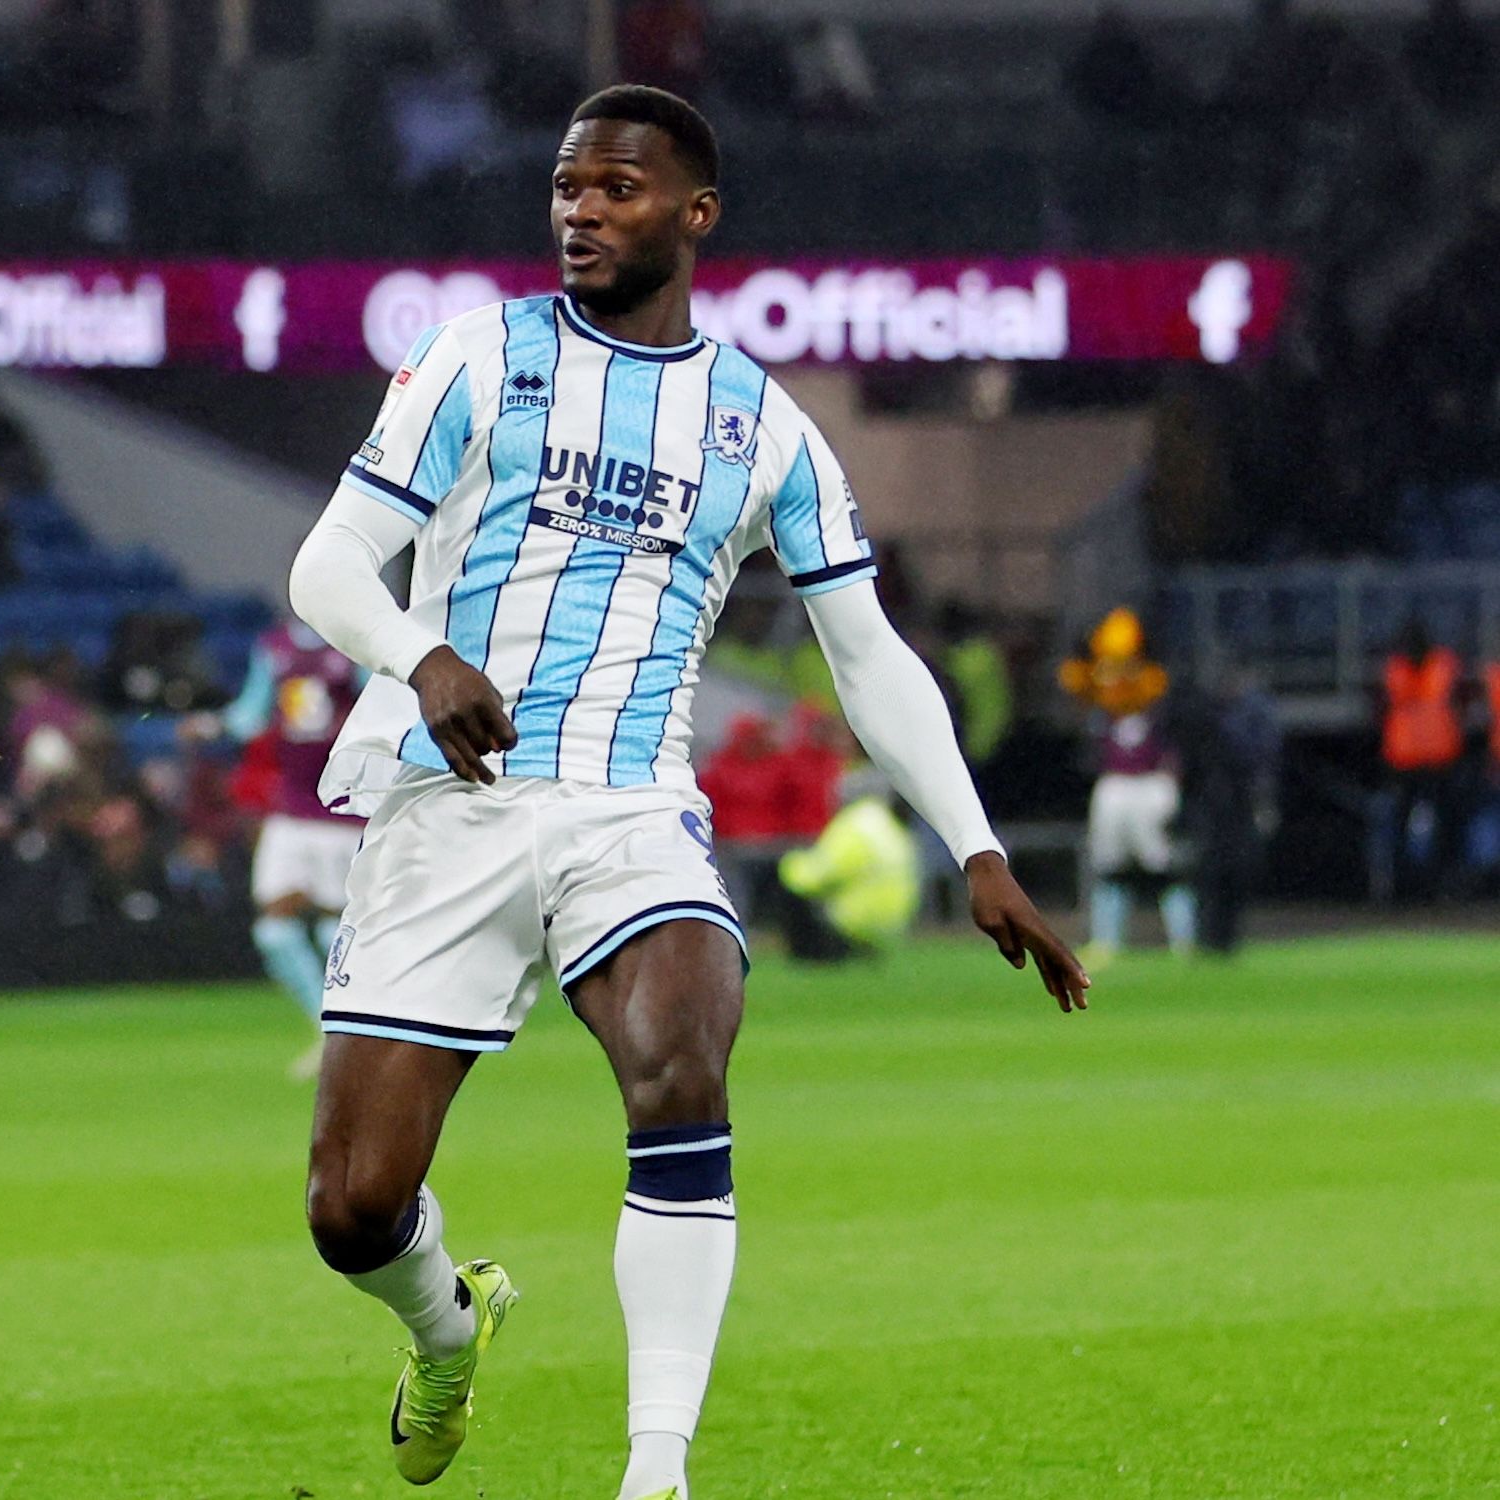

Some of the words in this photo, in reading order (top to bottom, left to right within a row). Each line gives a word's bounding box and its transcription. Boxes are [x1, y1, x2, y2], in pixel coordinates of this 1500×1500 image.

[542, 446, 700, 514] UNIBET
[548, 514, 602, 538] ZERO%
[605, 528, 667, 552] MISSION
